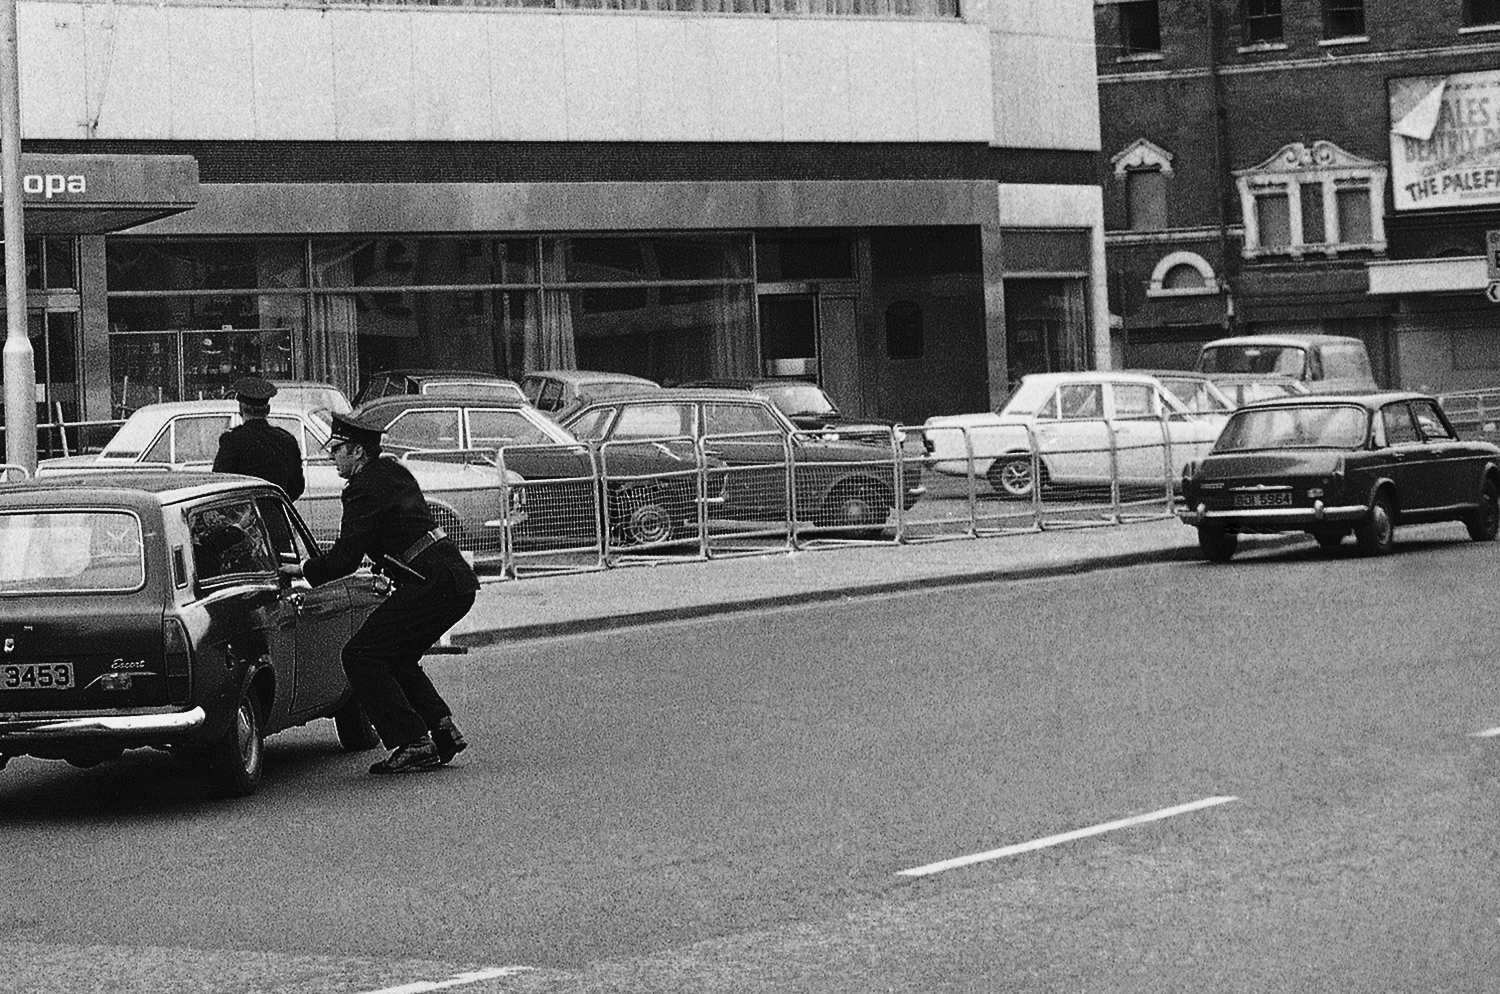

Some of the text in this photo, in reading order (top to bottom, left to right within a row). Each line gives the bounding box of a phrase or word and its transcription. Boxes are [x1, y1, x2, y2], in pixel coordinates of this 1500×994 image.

[1405, 177, 1439, 202] THE
[111, 658, 146, 669] Escort
[4, 664, 70, 689] 3453
